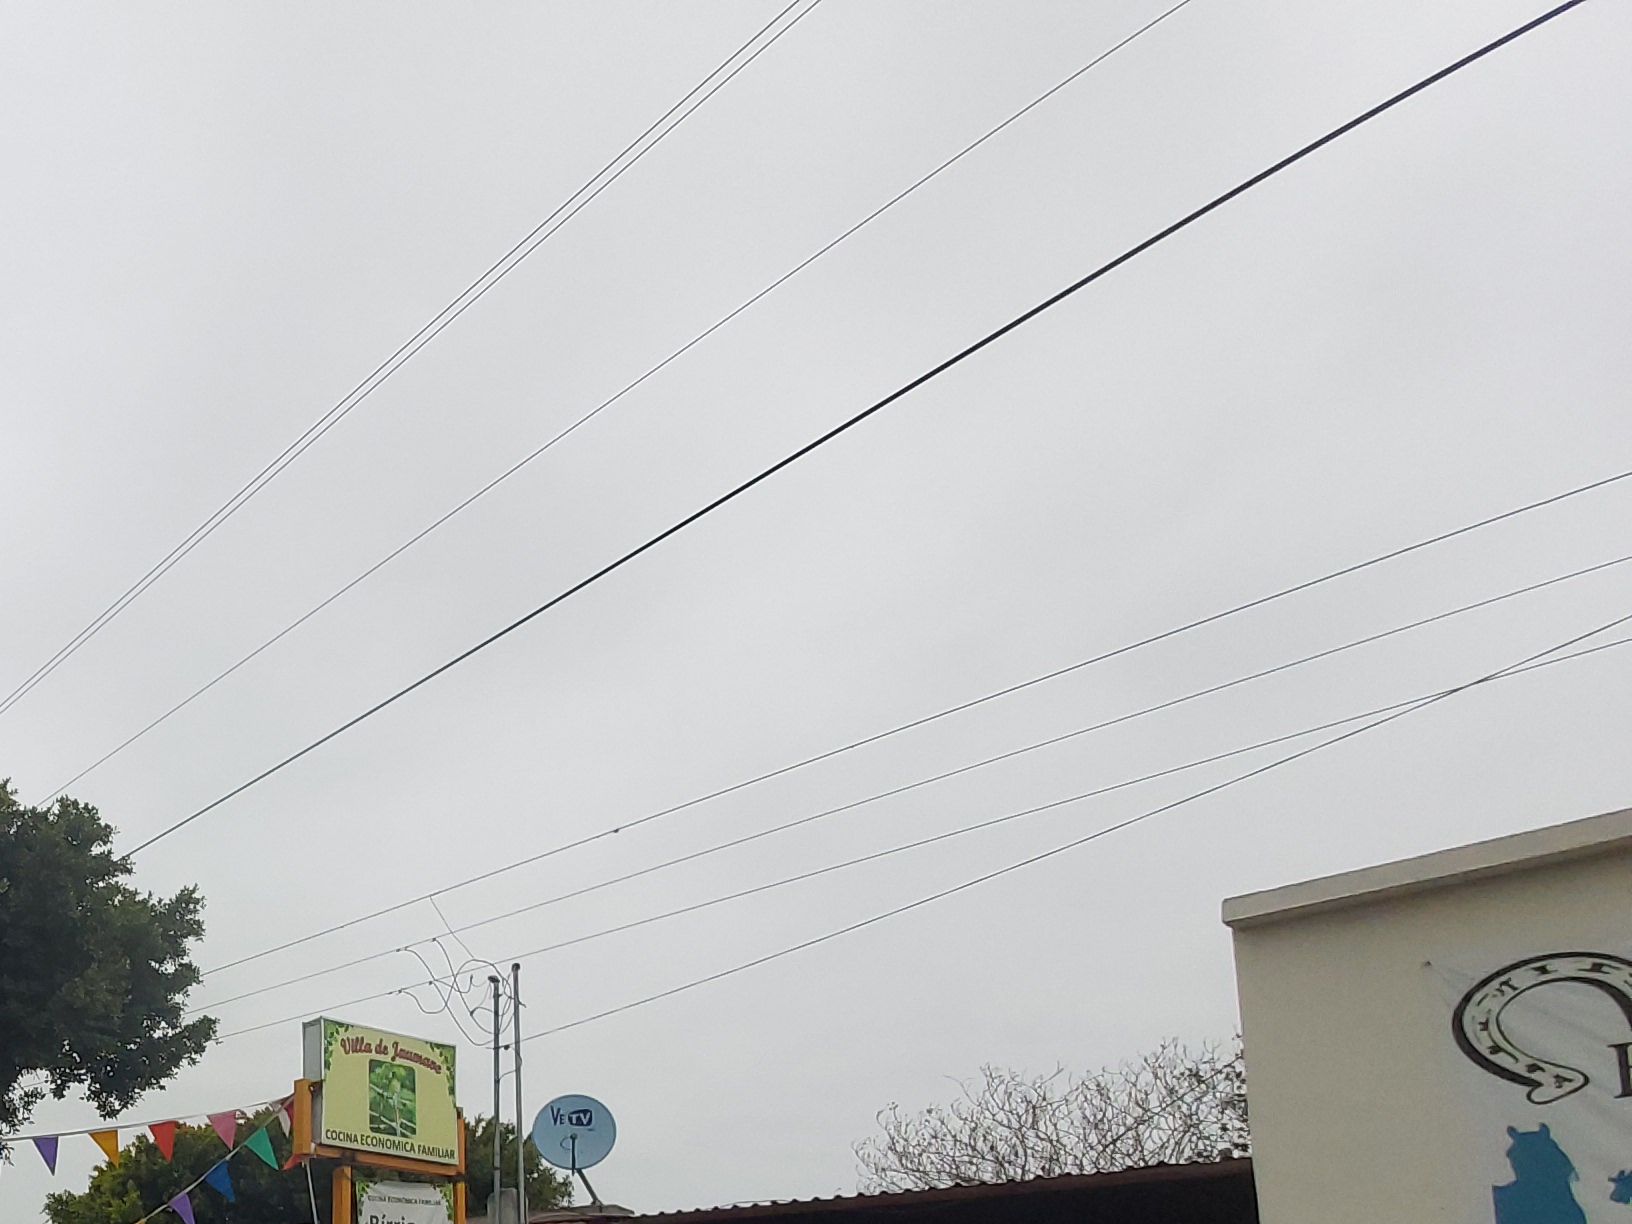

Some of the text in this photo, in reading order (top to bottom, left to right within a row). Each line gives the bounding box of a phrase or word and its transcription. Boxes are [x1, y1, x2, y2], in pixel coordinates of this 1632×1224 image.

[340, 1036, 373, 1055] Villa
[374, 1038, 389, 1055] de
[325, 1129, 359, 1144] COCINA
[417, 1144, 455, 1159] FAMILIAR
